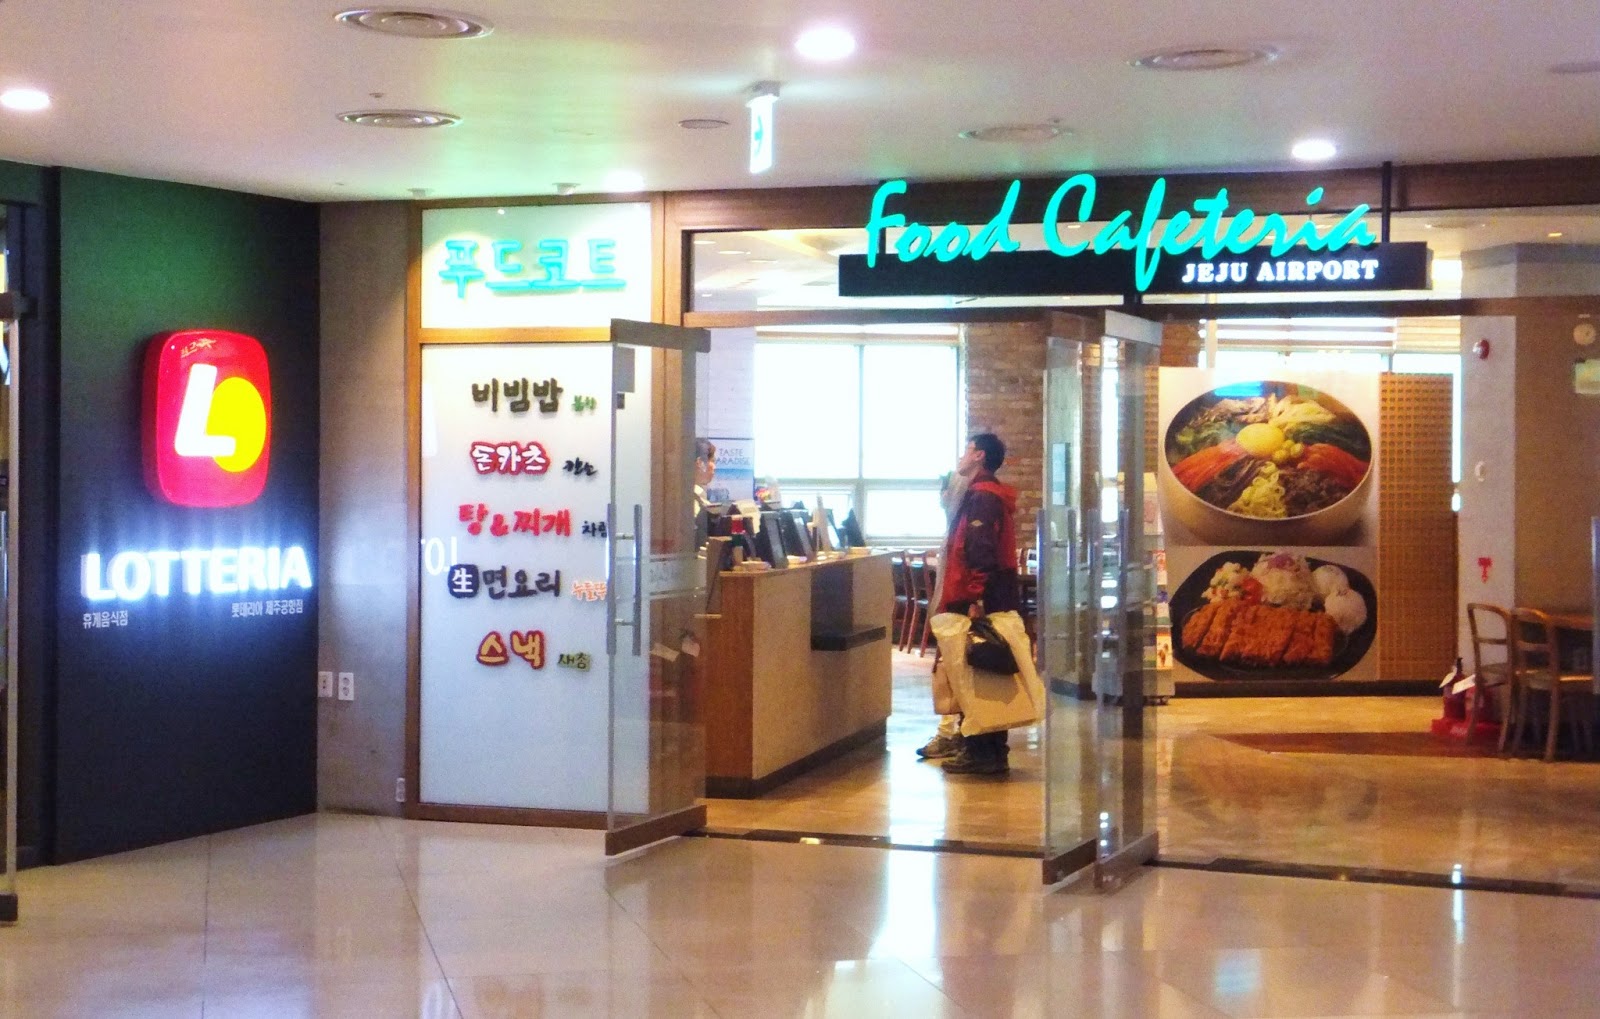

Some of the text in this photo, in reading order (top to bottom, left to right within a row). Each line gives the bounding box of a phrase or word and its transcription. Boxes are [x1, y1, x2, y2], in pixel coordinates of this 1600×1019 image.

[865, 173, 1376, 292] Food Cafeteria
[438, 239, 627, 300] 푸드코트
[1181, 259, 1380, 284] JEJU AIRPORT
[471, 377, 564, 413] 비빔밥
[470, 441, 551, 476] 돈카츠
[716, 457, 751, 466] ARADISE
[719, 448, 744, 457] TASTE
[80, 546, 313, 602] LOTTERIA
[82, 610, 128, 630] 휴게음식점
[231, 599, 304, 618] 롯데리아 제주공항점
[476, 630, 545, 670] 스낵
